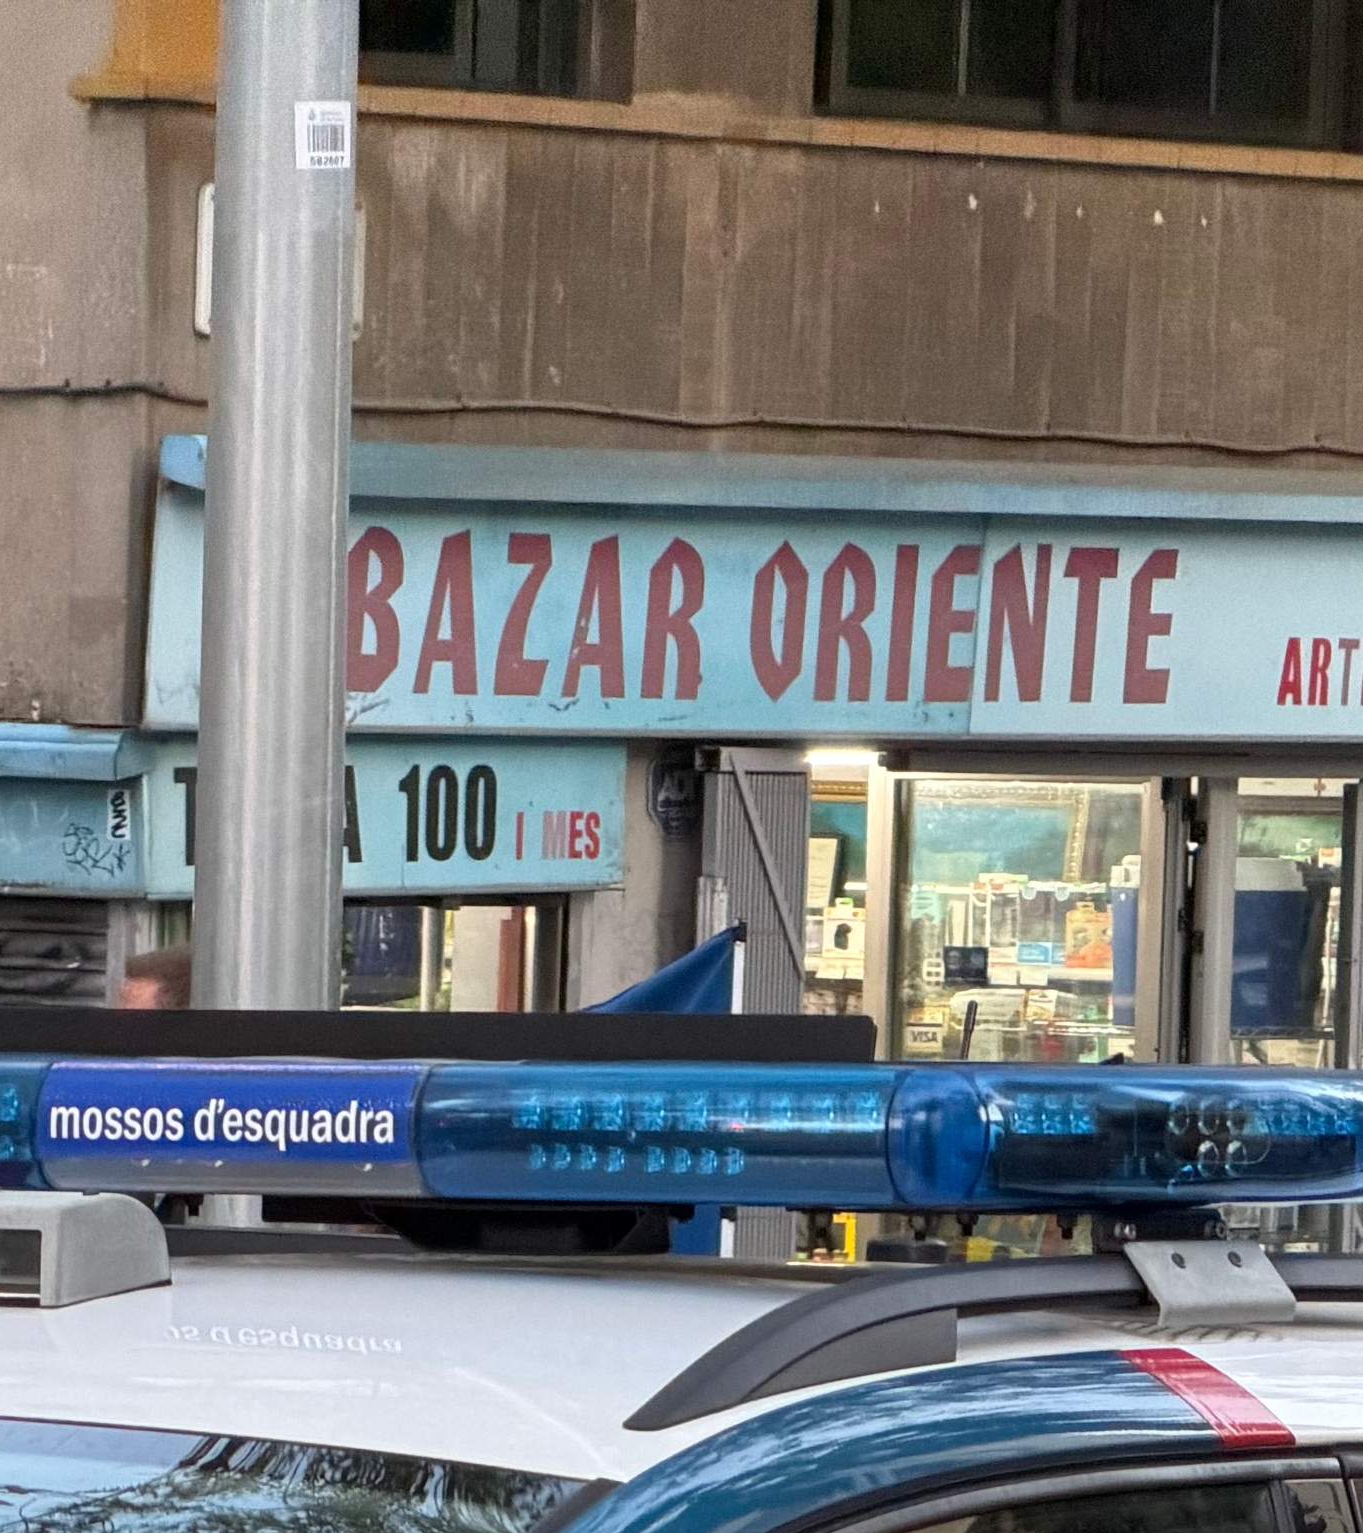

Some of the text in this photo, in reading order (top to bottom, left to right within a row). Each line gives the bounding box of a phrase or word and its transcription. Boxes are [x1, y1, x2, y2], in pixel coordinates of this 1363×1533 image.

[347, 527, 1179, 704] BAZAR ORIENTE
[1277, 636, 1363, 706] ART
[399, 764, 498, 863] 100
[911, 1030, 939, 1043] VISA
[50, 1098, 395, 1151] mossos d'esquadra
